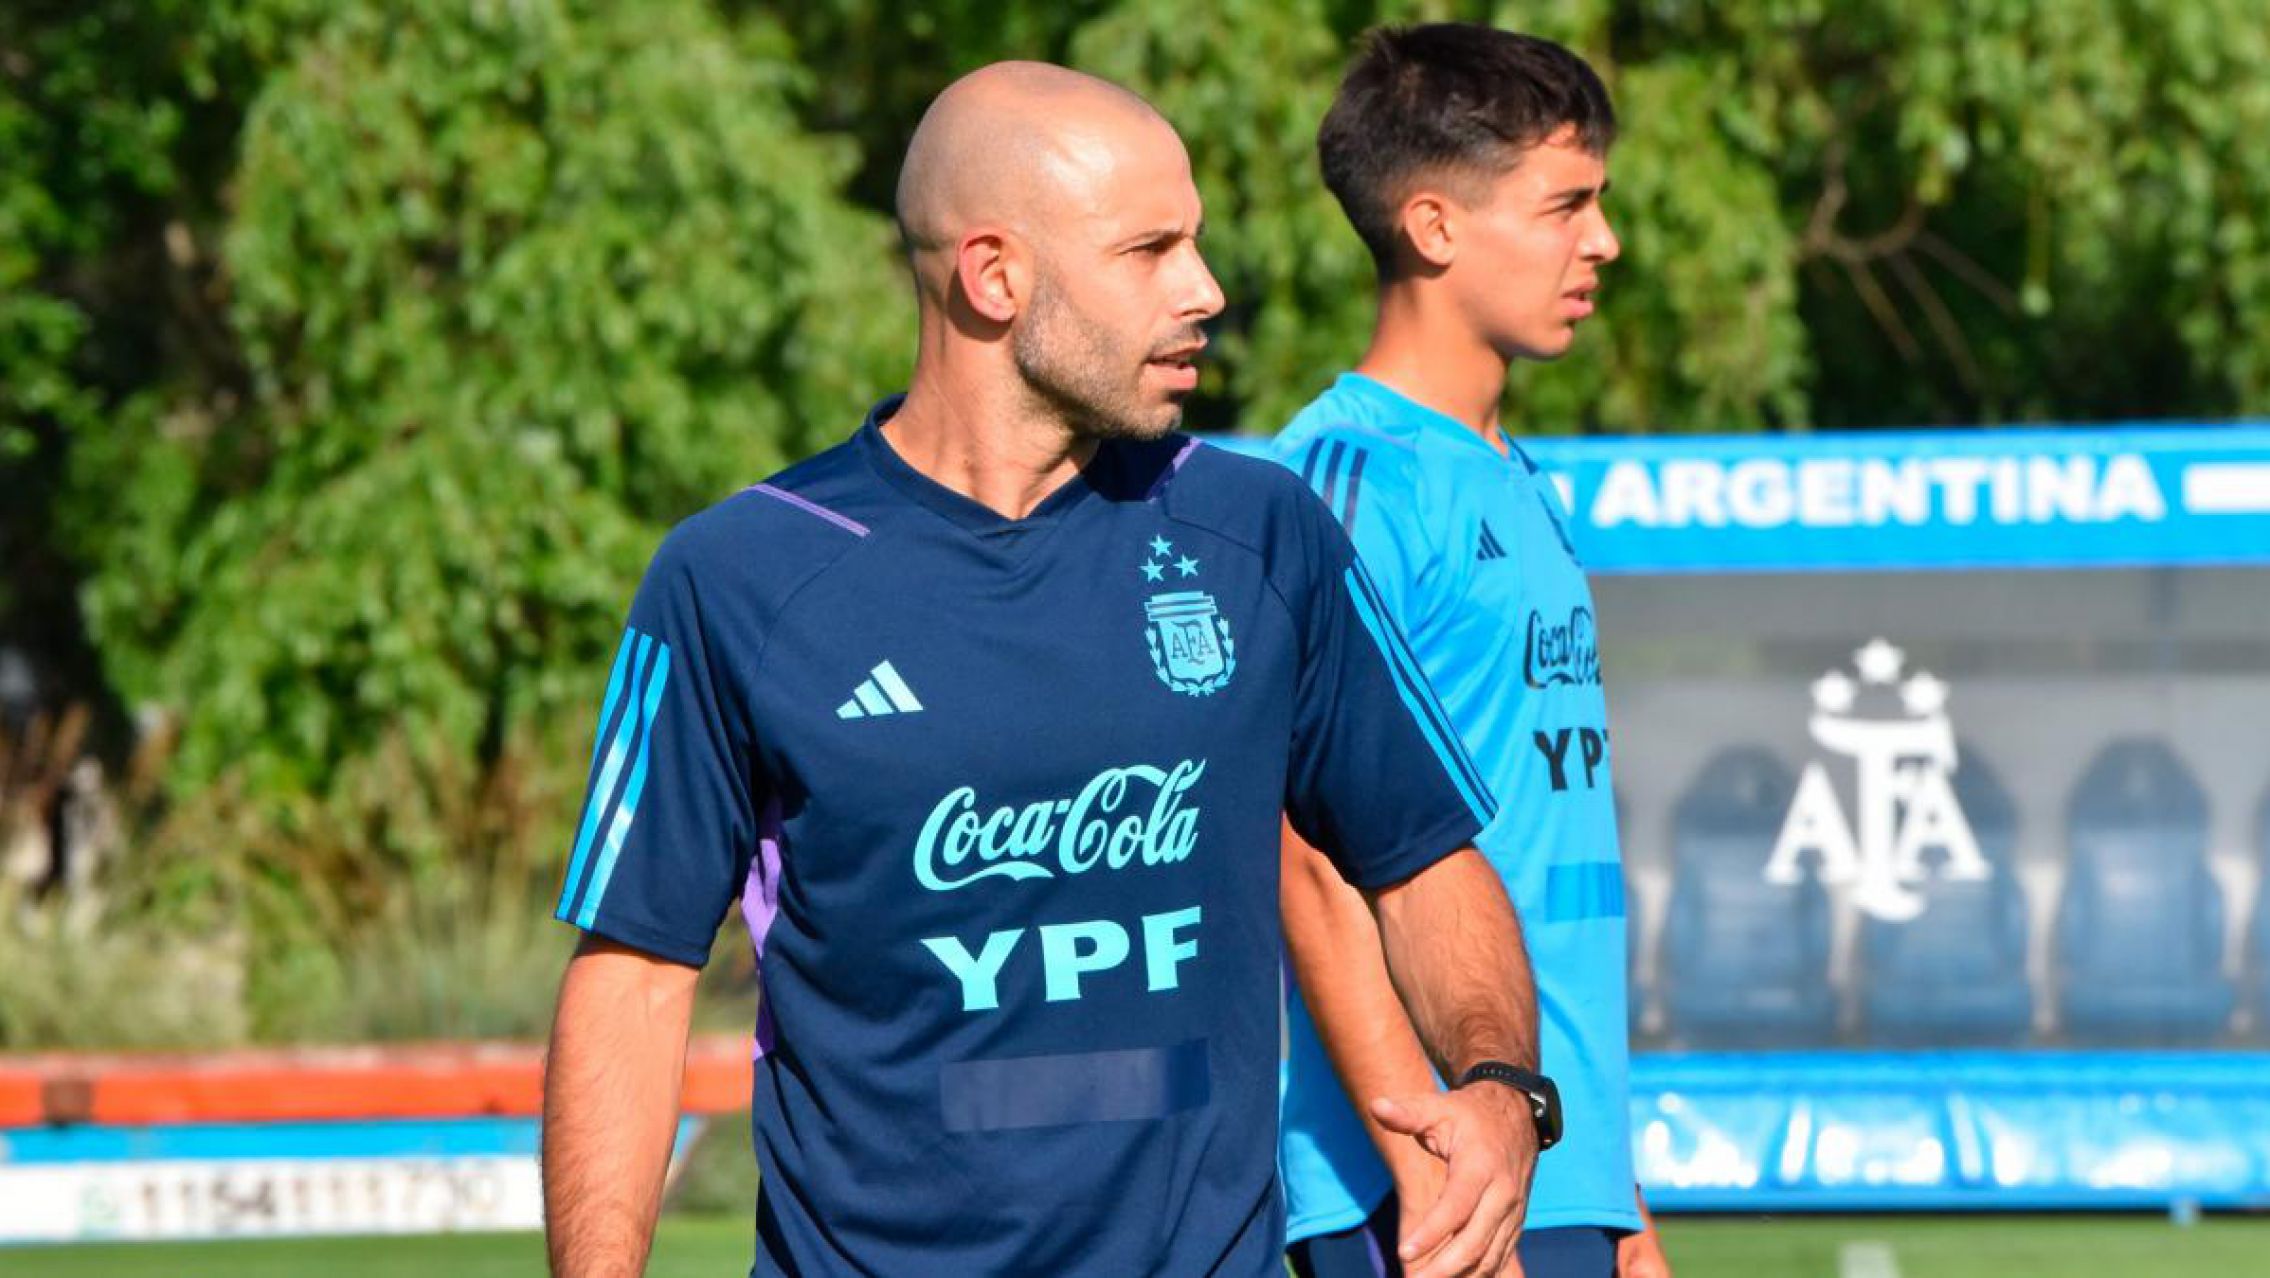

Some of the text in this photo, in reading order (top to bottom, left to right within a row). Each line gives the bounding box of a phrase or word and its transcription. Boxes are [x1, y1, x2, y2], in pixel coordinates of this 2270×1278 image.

[1590, 455, 2167, 526] ARGENTINA
[1170, 619, 1216, 665] AFA
[1533, 726, 1608, 791] YP
[913, 758, 1206, 891] Coca-Cola
[1762, 711, 1991, 920] AFA
[919, 905, 1201, 1012] YPF
